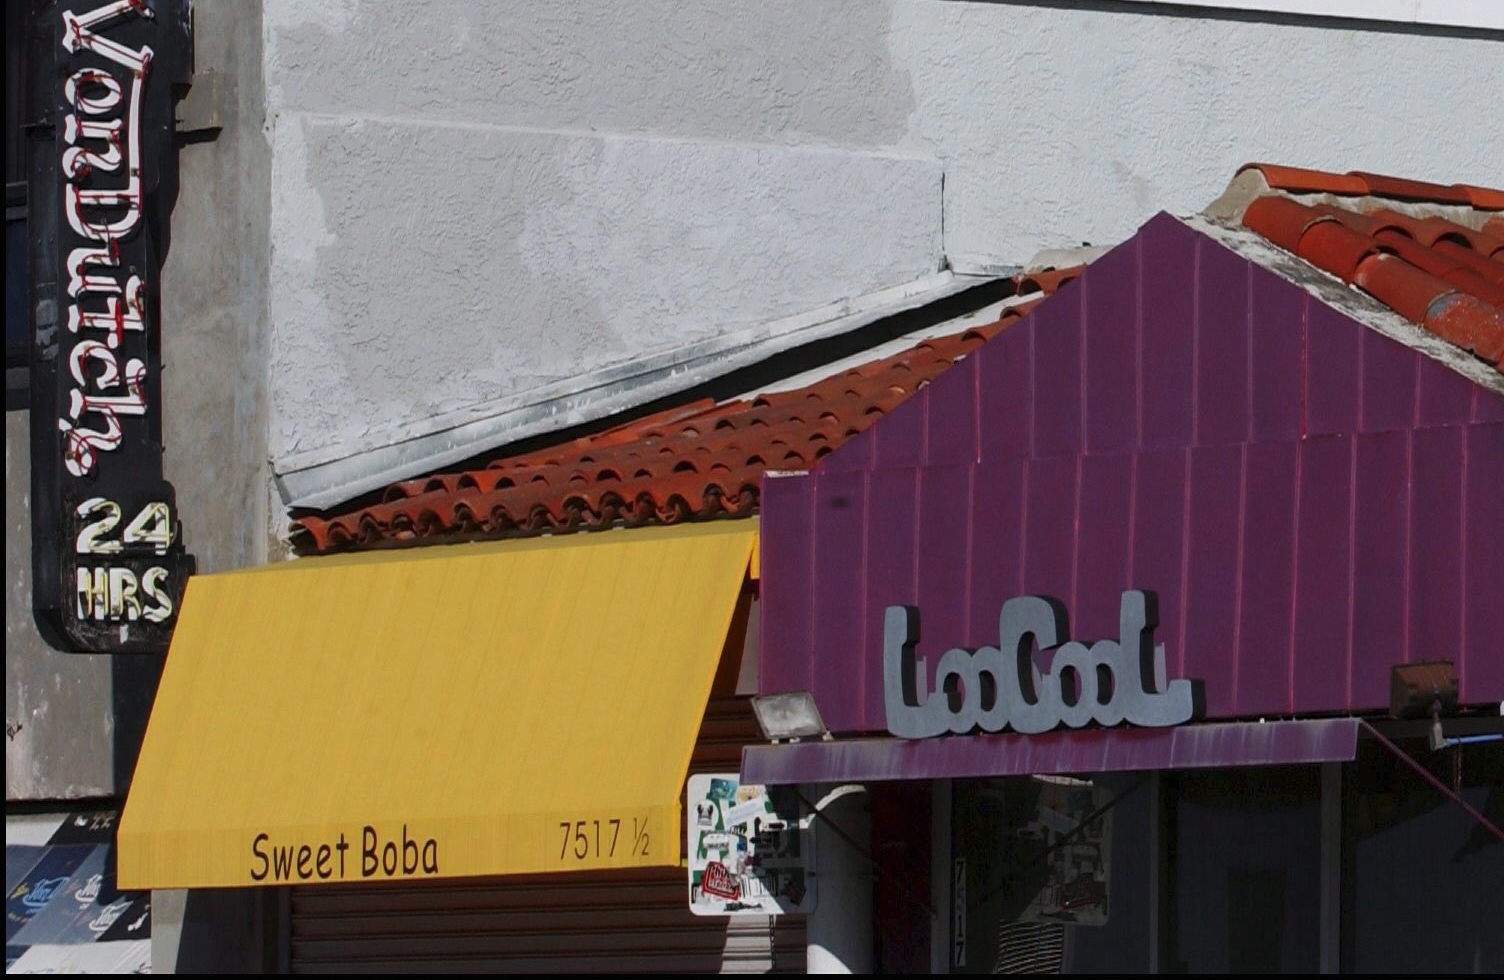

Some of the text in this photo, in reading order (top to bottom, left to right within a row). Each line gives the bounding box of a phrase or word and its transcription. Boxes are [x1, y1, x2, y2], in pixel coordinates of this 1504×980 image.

[75, 497, 174, 556] 24
[77, 566, 173, 622] HRS
[250, 832, 350, 881] Sweet
[361, 823, 439, 877] Boba
[560, 818, 621, 861] 7517
